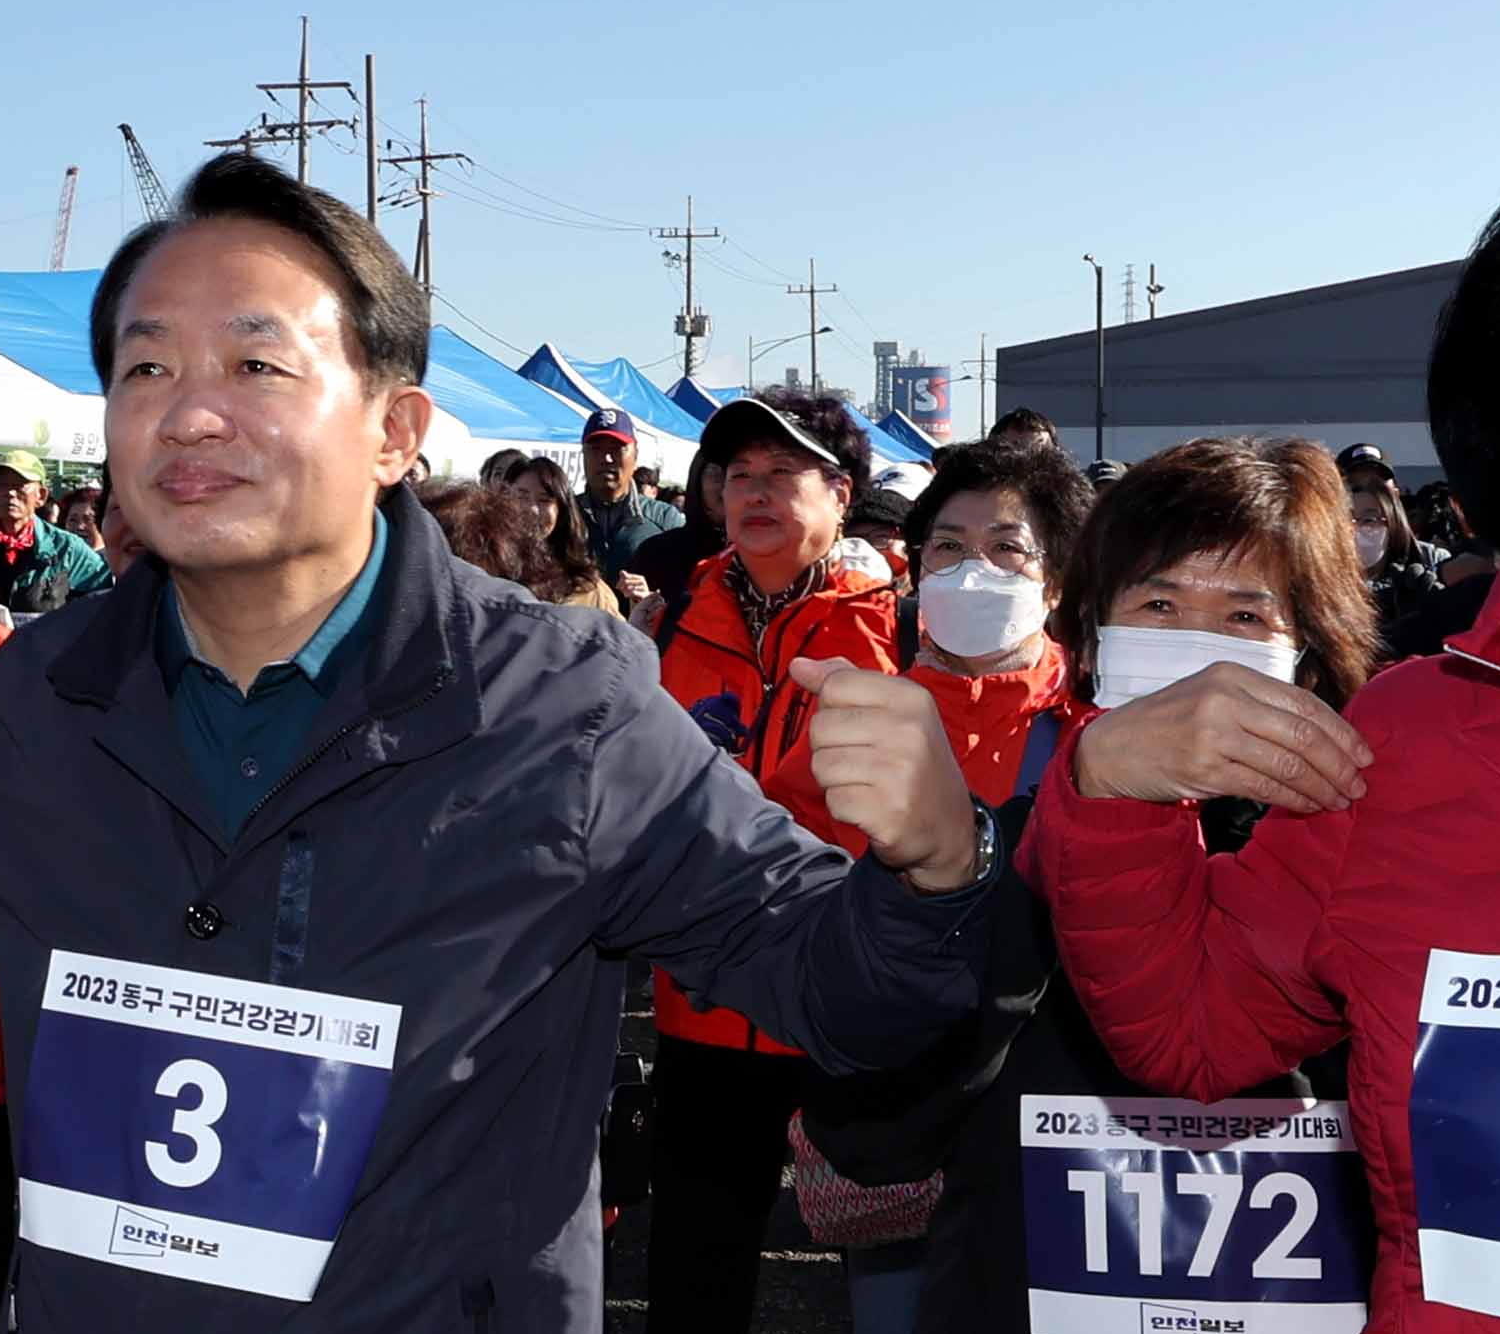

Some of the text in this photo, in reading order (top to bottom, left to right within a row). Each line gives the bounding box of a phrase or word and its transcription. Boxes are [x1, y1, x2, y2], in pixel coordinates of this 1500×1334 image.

[61, 971, 381, 1051] 2023 동구 구민건강걷기대회
[144, 1057, 229, 1189] 3
[1035, 1112, 1343, 1141] 2023 동구 구민건강걷기대회
[121, 1224, 220, 1259] 인천일보
[1066, 1169, 1323, 1280] 1172
[1150, 1316, 1246, 1334] 인천일보
